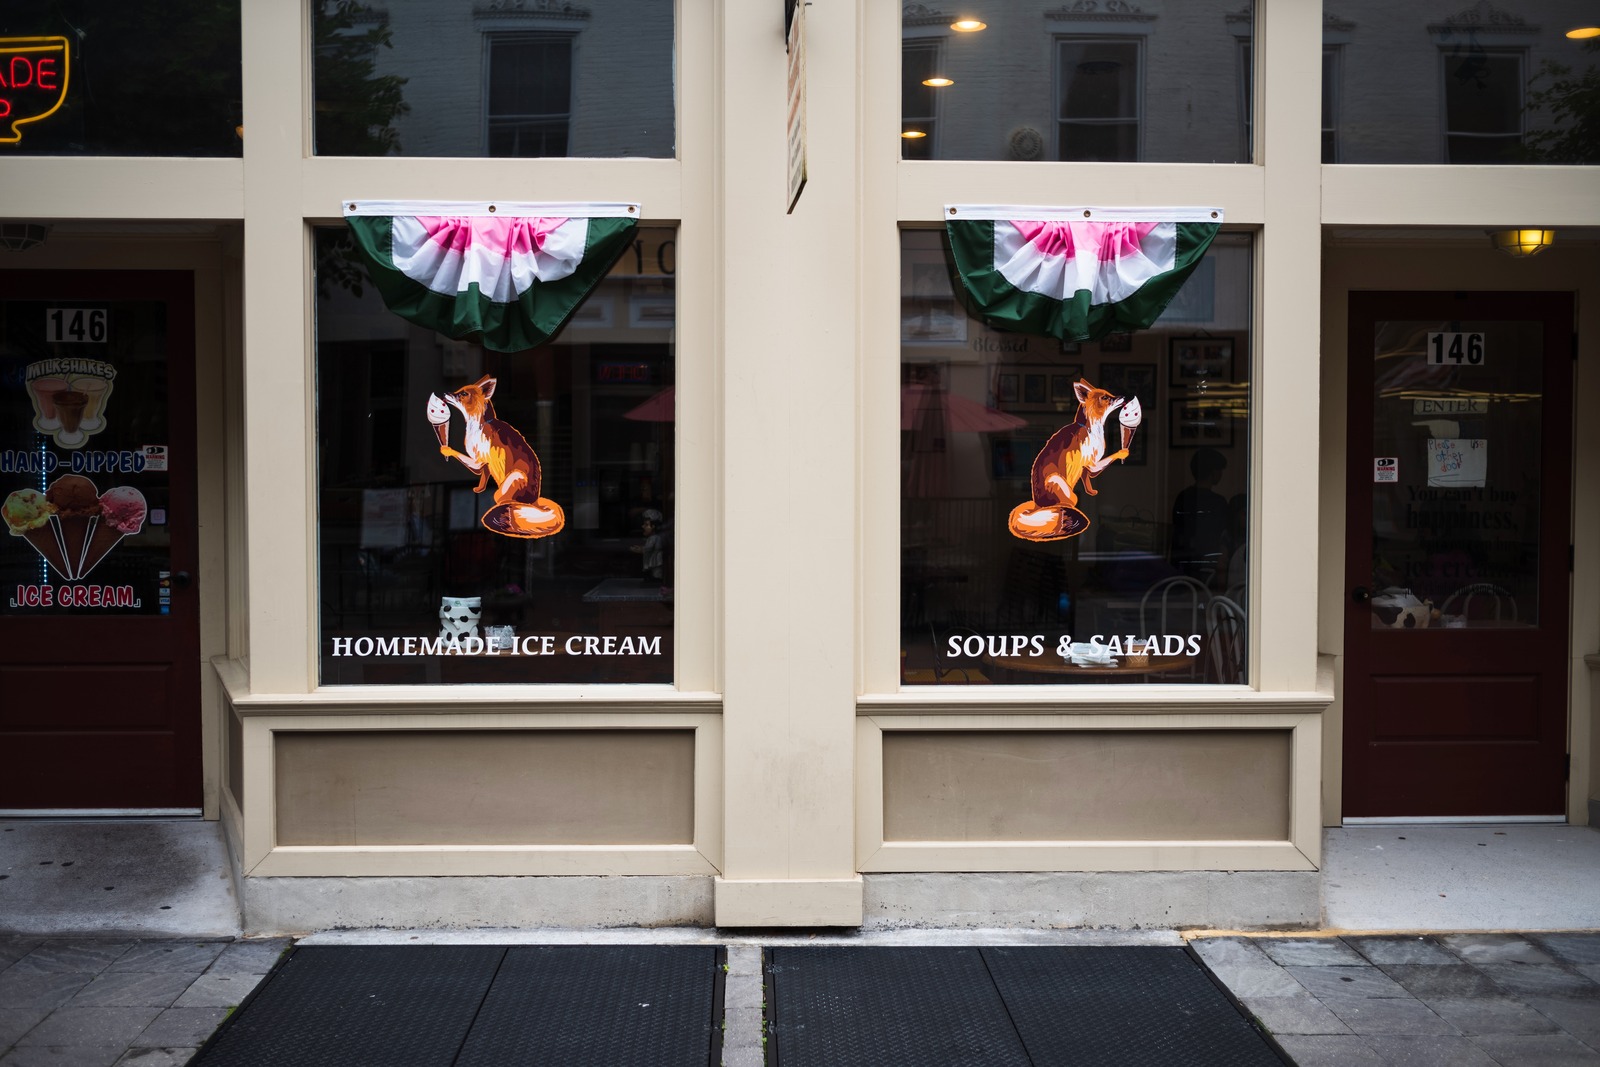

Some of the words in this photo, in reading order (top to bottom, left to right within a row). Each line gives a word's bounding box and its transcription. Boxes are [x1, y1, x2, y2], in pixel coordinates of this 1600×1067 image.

[51, 310, 105, 342] 146
[1432, 333, 1482, 364] 146
[27, 358, 115, 381] MILKSHAKES
[1422, 400, 1478, 413] ENTER
[0, 450, 145, 473] HAND-DIPPED
[17, 585, 52, 607] ICE
[58, 585, 134, 607] CREAM
[331, 636, 500, 656] HOMEMADE
[510, 636, 555, 656] ICE
[565, 635, 662, 656] CREAM
[946, 635, 1045, 658] SOUPS
[1056, 634, 1073, 657] &
[1088, 634, 1202, 657] SALADS
